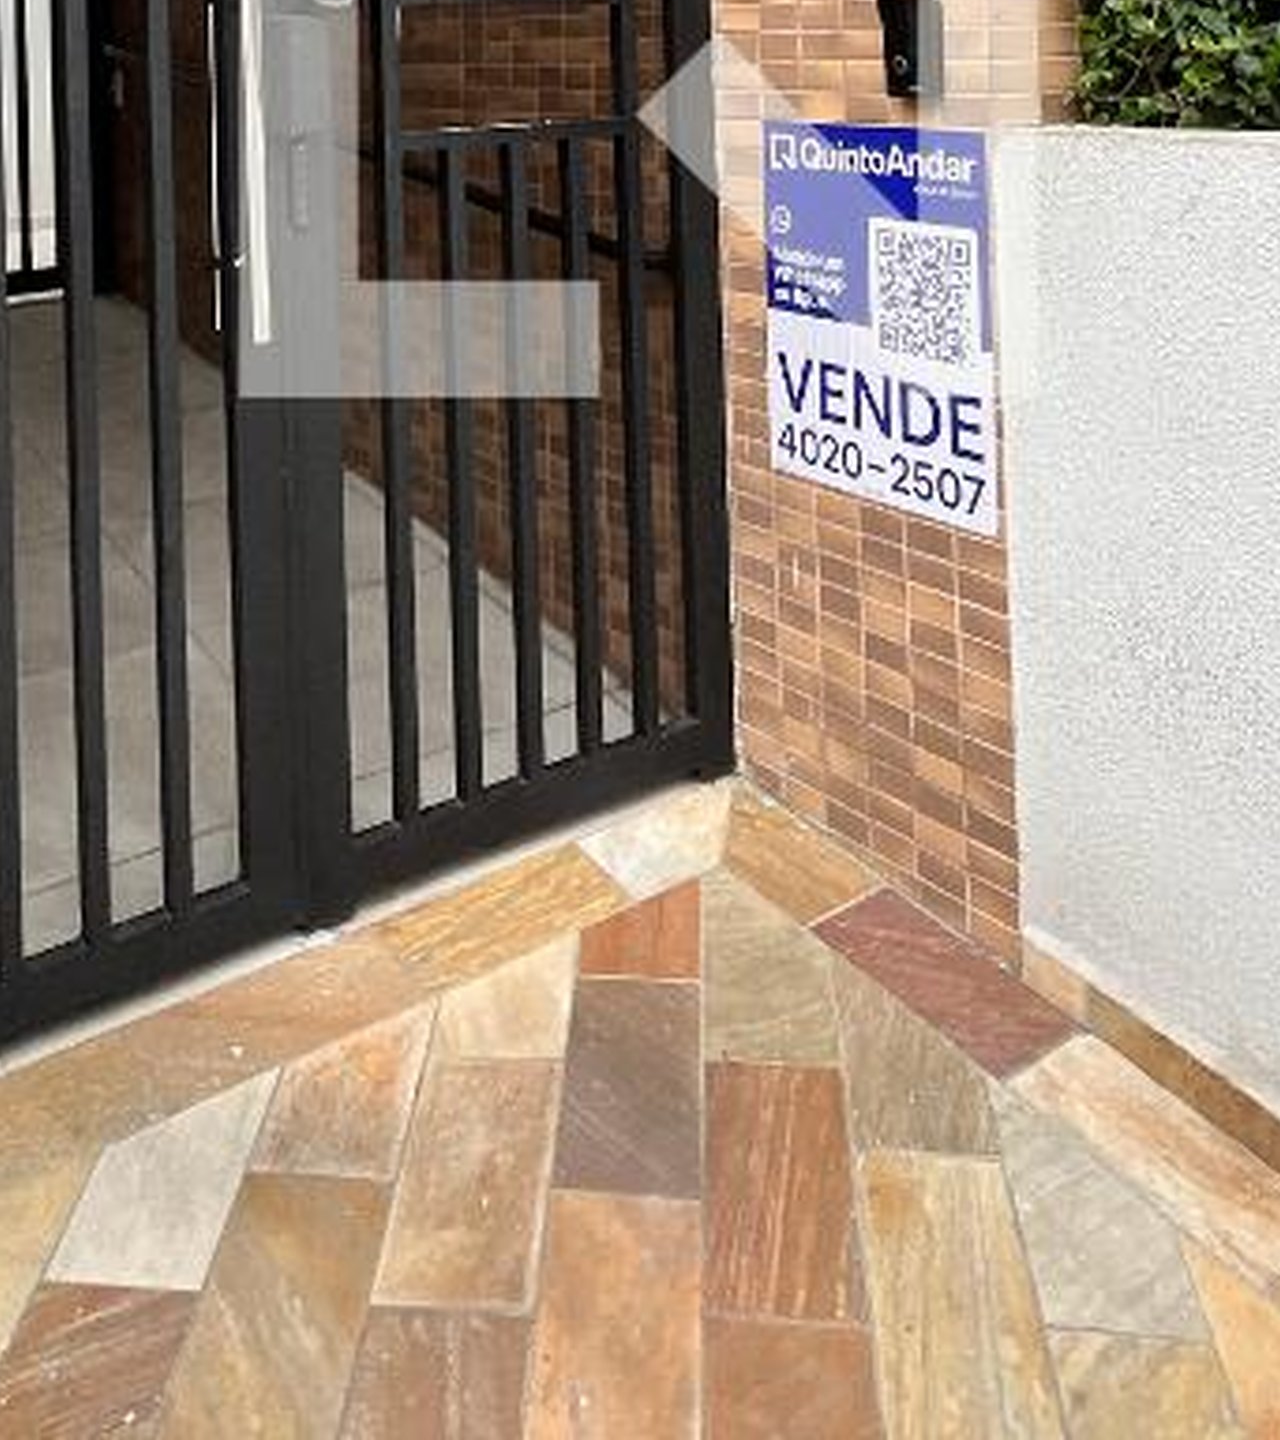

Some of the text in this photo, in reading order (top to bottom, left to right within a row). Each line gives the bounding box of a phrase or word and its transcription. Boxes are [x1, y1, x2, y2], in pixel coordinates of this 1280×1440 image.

[800, 137, 978, 184] QuintoAndar
[777, 351, 985, 462] VENDE
[777, 421, 986, 516] 4020-2507
